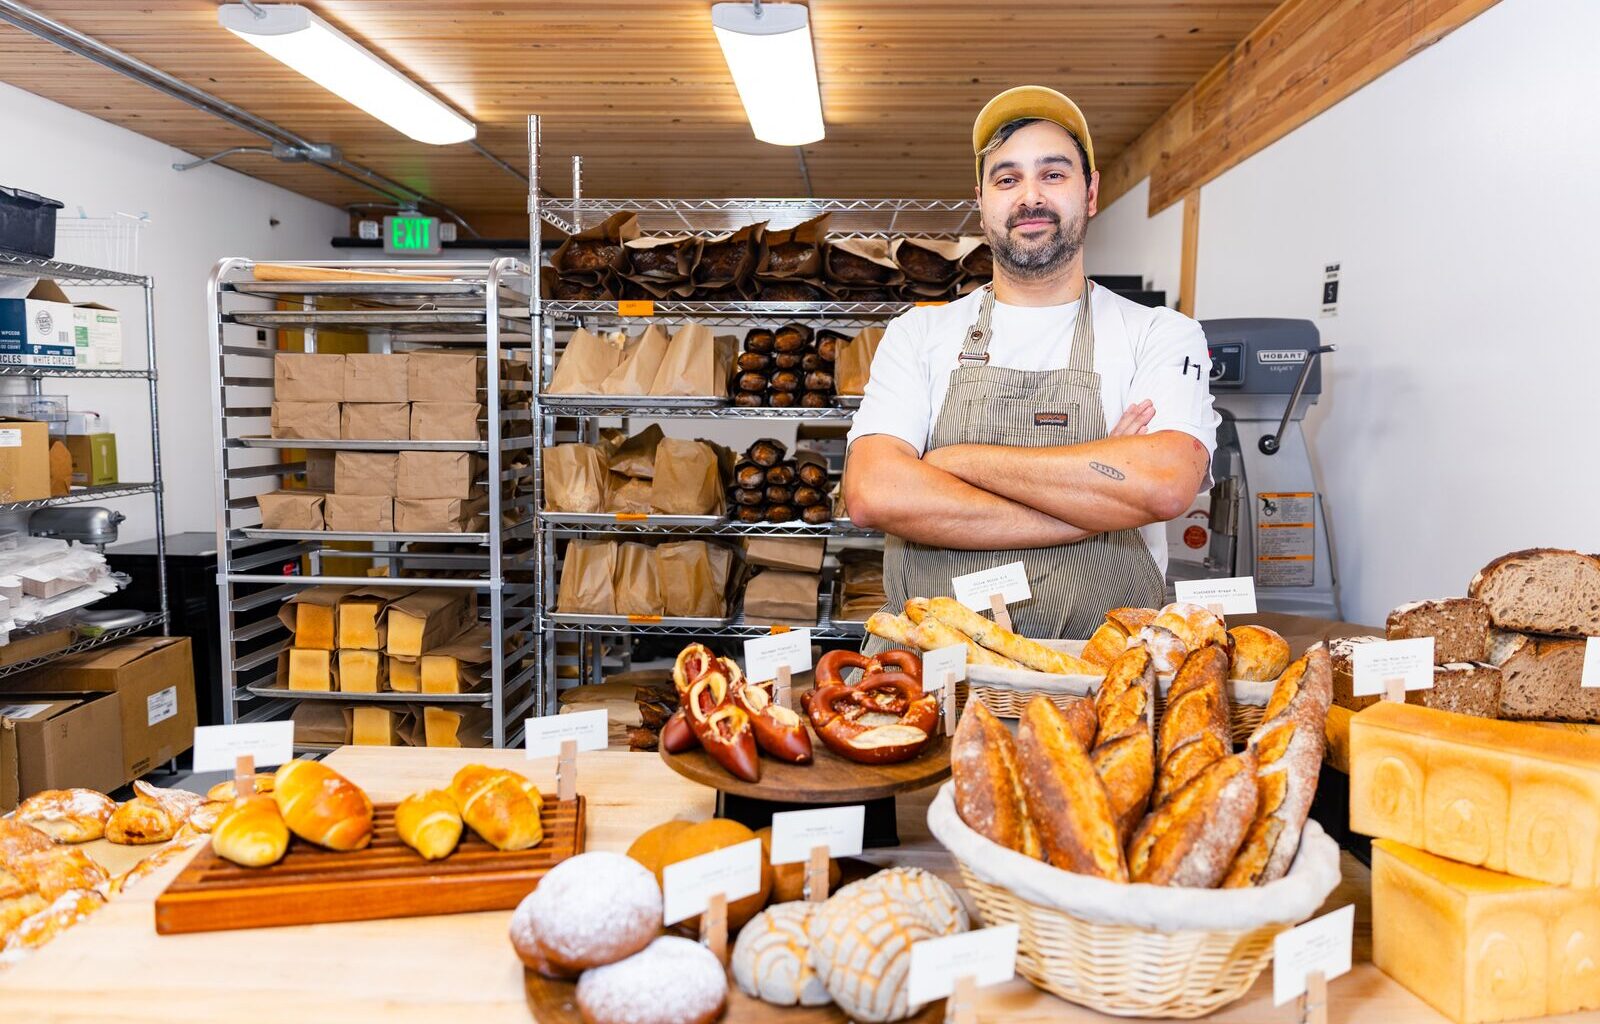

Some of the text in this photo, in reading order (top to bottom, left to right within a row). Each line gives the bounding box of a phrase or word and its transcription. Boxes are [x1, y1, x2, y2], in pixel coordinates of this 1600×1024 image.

[392, 217, 432, 249] EXIT
[33, 356, 75, 365] WHITE CIRCLES
